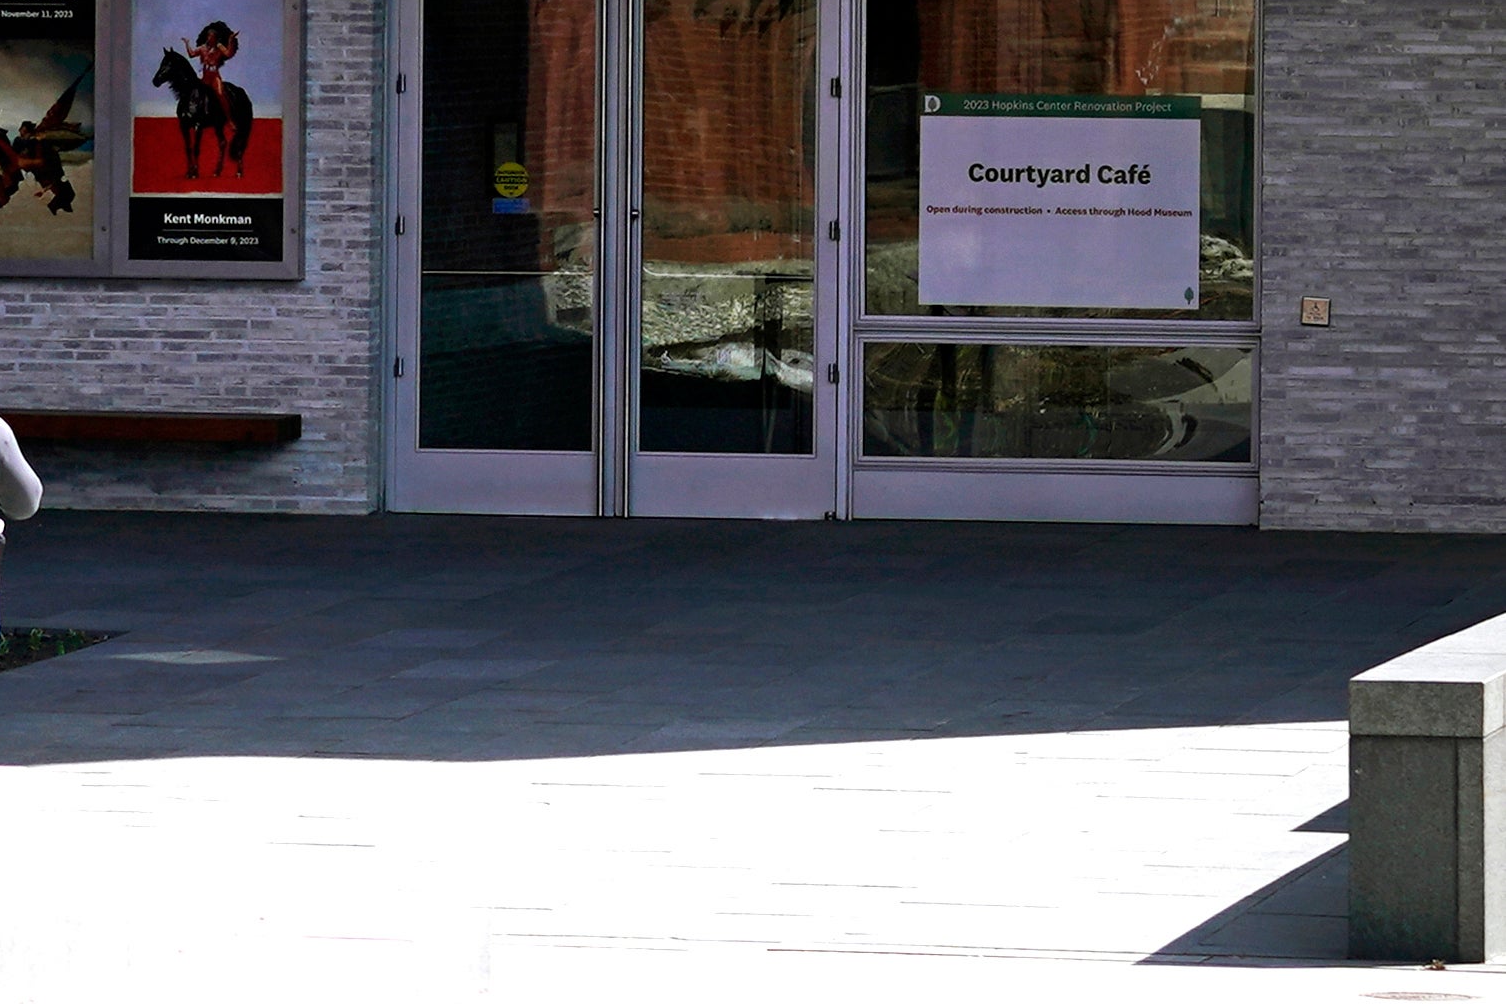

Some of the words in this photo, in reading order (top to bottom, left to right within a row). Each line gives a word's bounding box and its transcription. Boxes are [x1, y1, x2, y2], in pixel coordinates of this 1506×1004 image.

[1, 10, 40, 18] November
[54, 10, 74, 19] 2023
[963, 99, 990, 110] 2023
[991, 99, 1035, 112] Hopkins
[1036, 100, 1072, 111] Center
[1074, 100, 1132, 112] Renovation
[1134, 101, 1172, 114] Project
[967, 163, 1091, 189] Courtyard
[1096, 163, 1152, 185] Café
[926, 204, 951, 216] Open
[952, 204, 983, 216] during
[983, 205, 1043, 215] construction
[1054, 206, 1087, 216] Access
[1089, 206, 1126, 218] through
[1127, 207, 1153, 217] Hood
[1153, 208, 1193, 217] Museum
[163, 212, 192, 224] Kent
[193, 213, 253, 225] Monkman
[156, 235, 189, 245] Through
[189, 236, 229, 245] December
